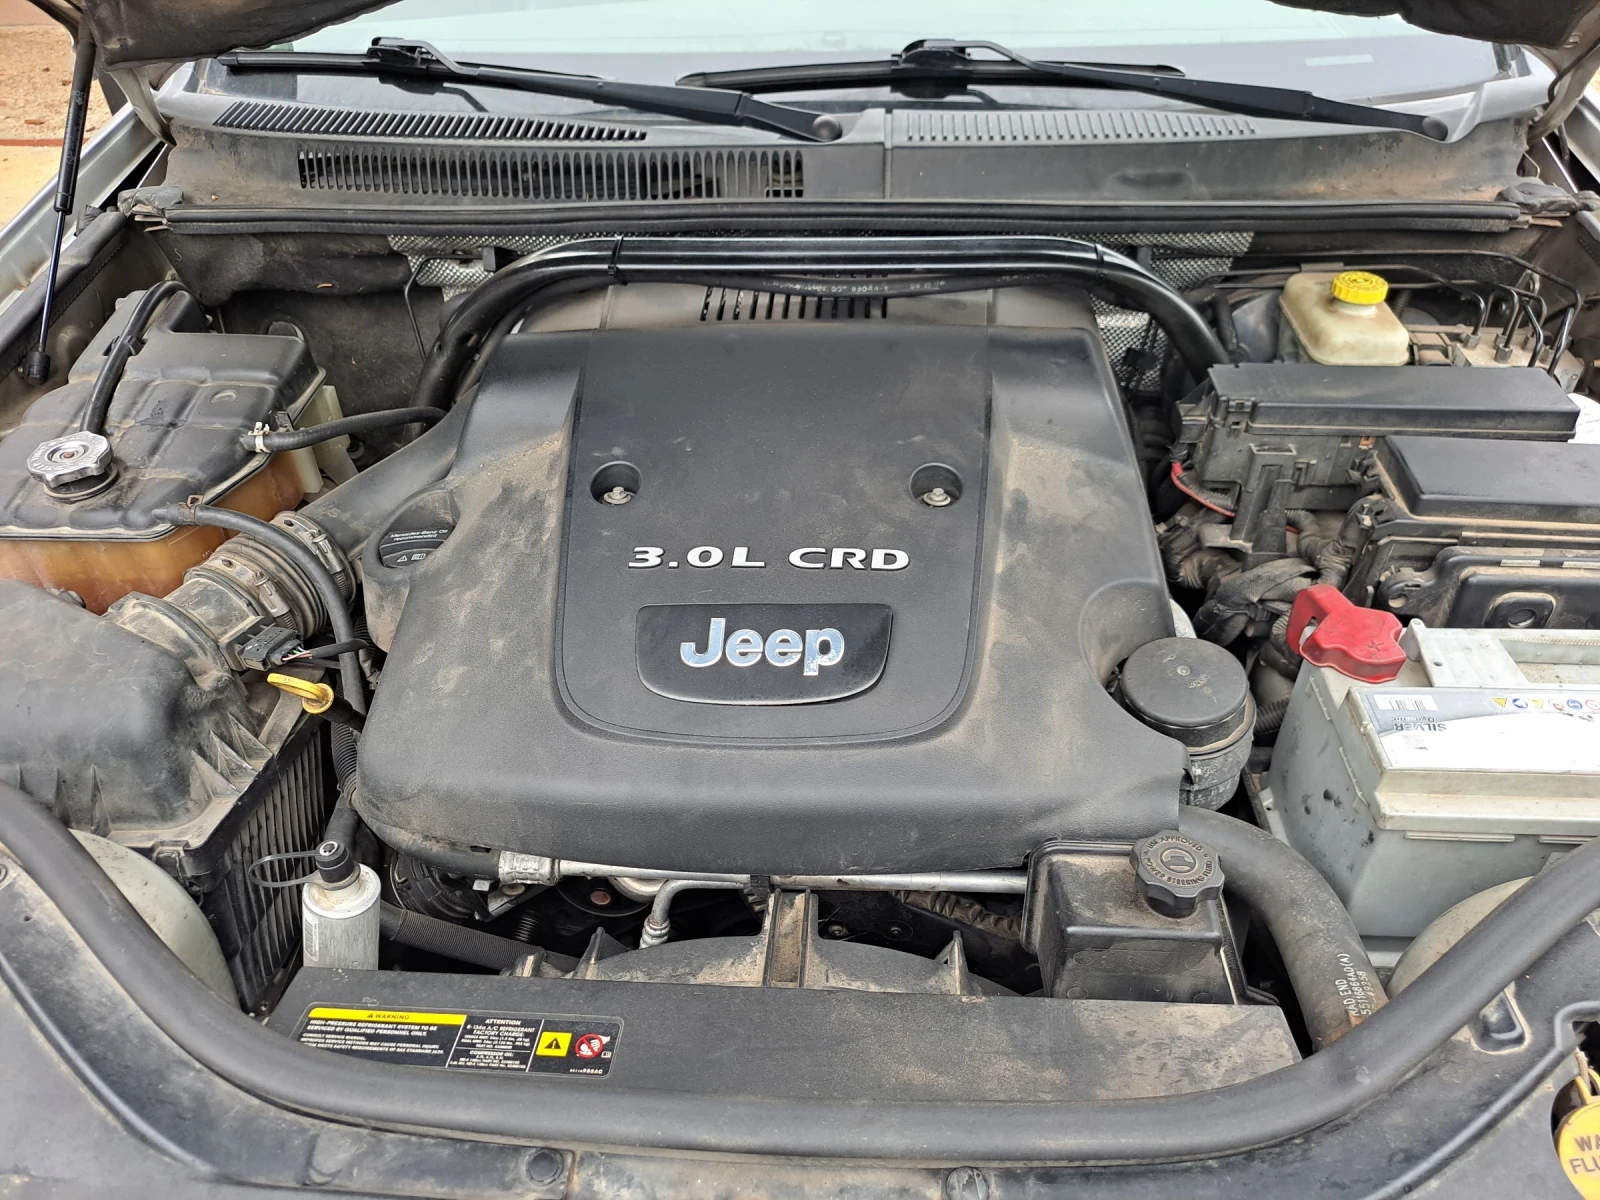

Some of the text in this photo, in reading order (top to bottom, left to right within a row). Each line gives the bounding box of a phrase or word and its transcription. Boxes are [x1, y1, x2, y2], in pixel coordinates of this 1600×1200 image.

[390, 530, 437, 538] Mercedes-Benz
[628, 546, 910, 570] 3.0L CRD
[680, 618, 845, 676] Jeep
[1393, 722, 1446, 731] SILVER
[1160, 836, 1203, 851] APPROVED
[1144, 858, 1166, 879] POWER
[1167, 876, 1204, 885] STEERING
[1335, 979, 1352, 996] END
